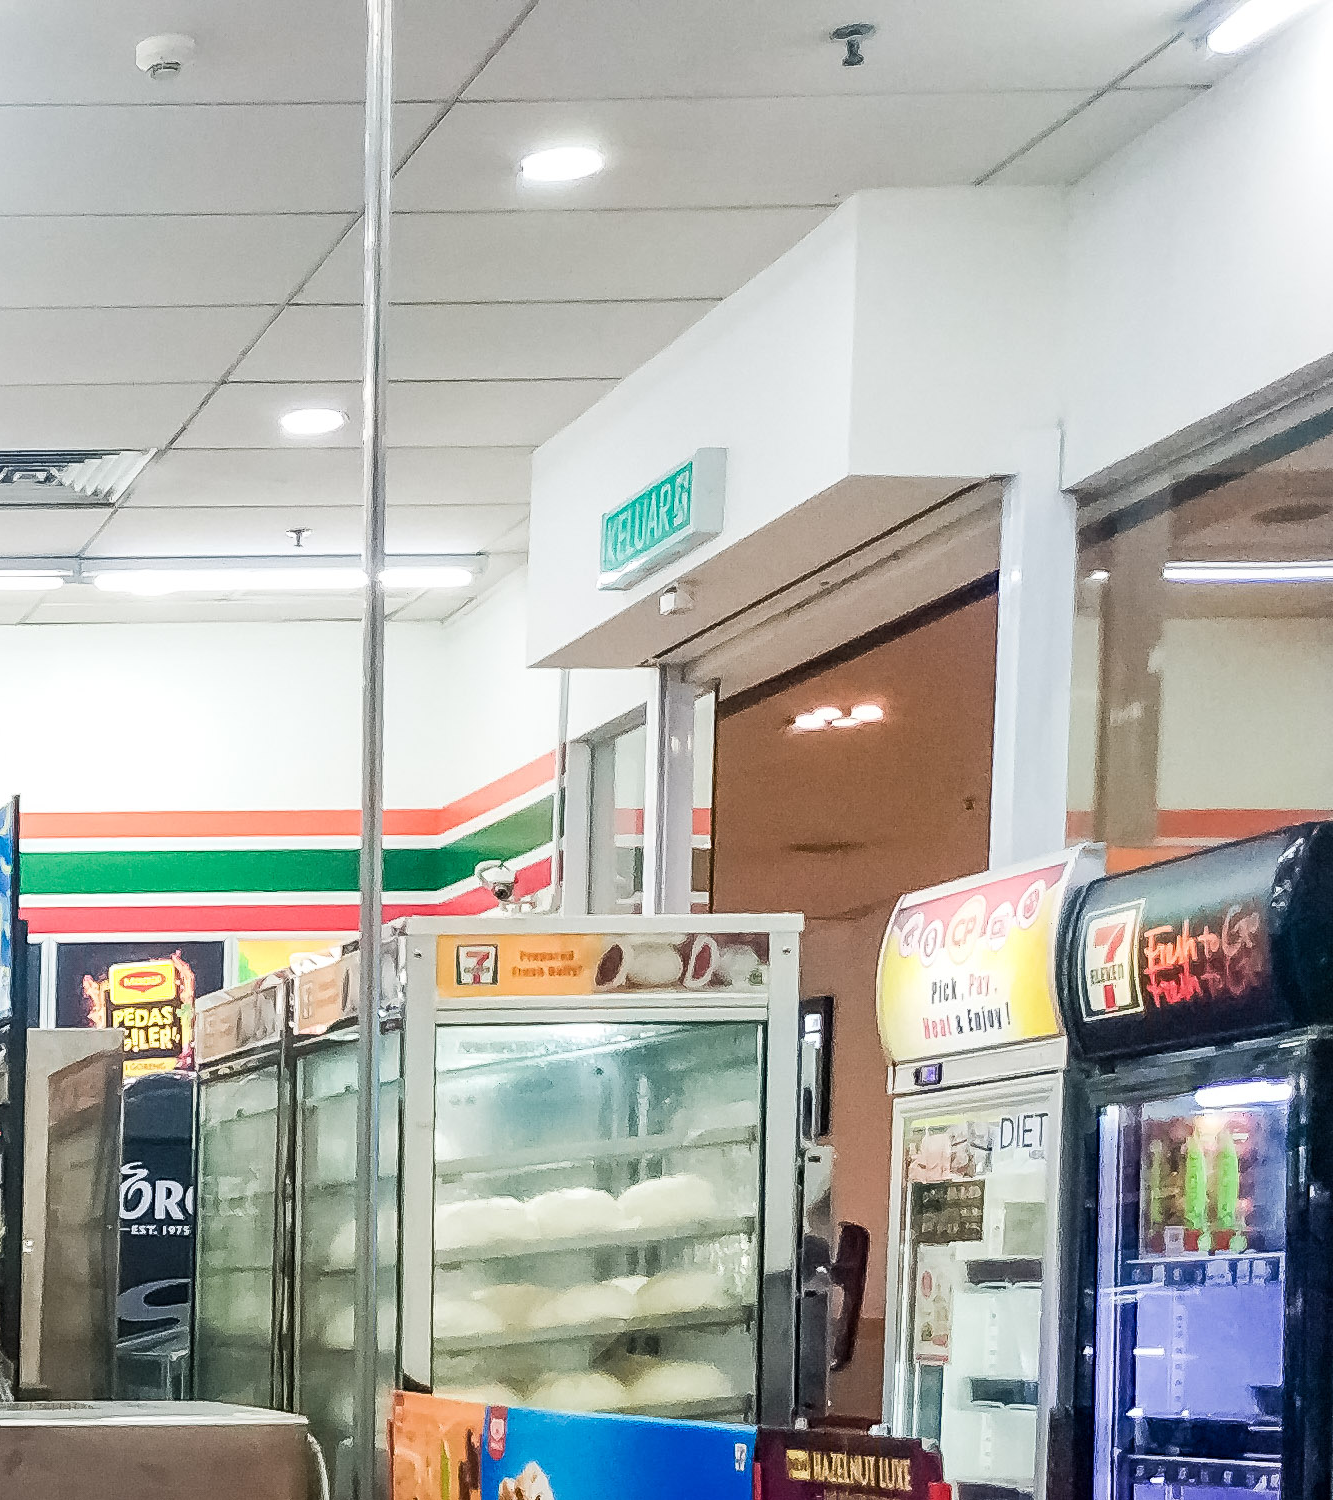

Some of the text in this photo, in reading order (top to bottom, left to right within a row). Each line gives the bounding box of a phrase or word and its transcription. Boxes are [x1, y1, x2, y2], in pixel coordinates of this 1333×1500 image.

[113, 1005, 174, 1029] PEDAS
[1000, 1113, 1048, 1149] DIET
[131, 1224, 191, 1236] EST. 1975
